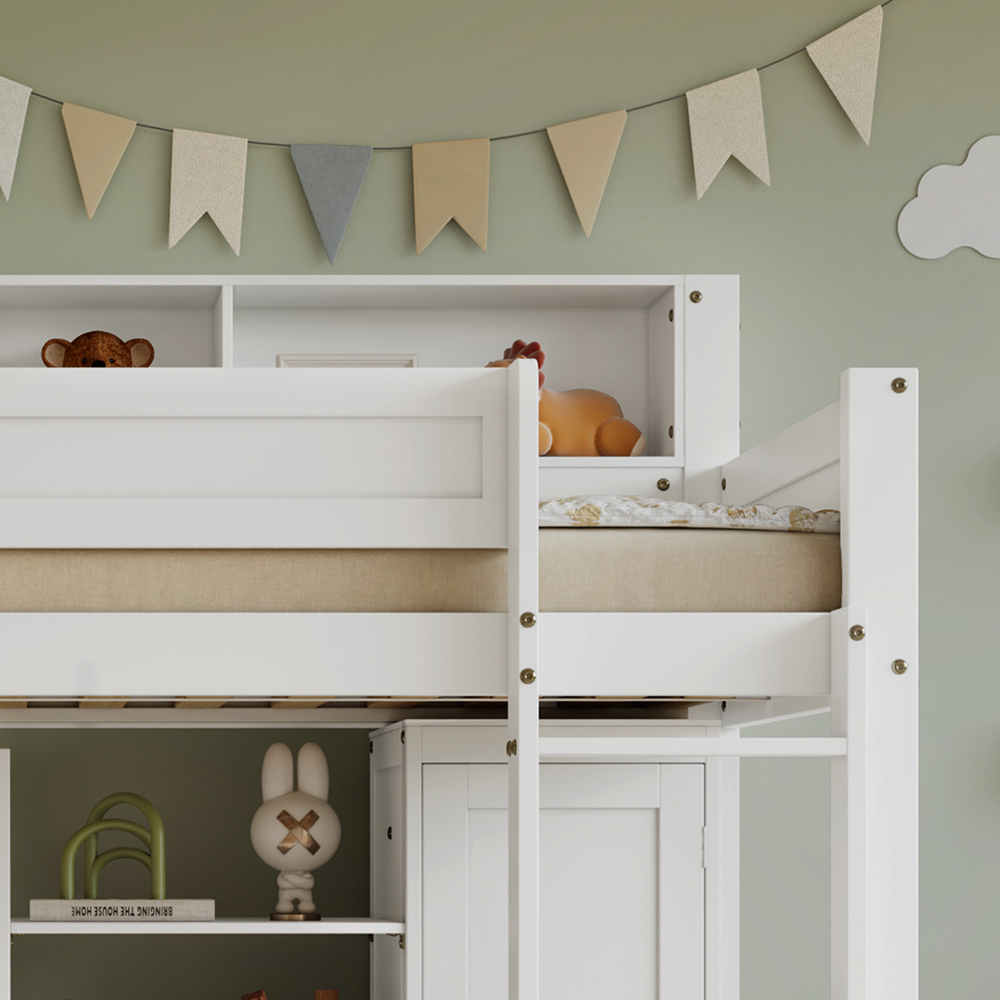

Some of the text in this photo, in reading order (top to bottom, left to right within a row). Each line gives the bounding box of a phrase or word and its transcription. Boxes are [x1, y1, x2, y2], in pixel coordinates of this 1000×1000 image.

[71, 906, 173, 916] BRINGING THE HOUSE HOME
